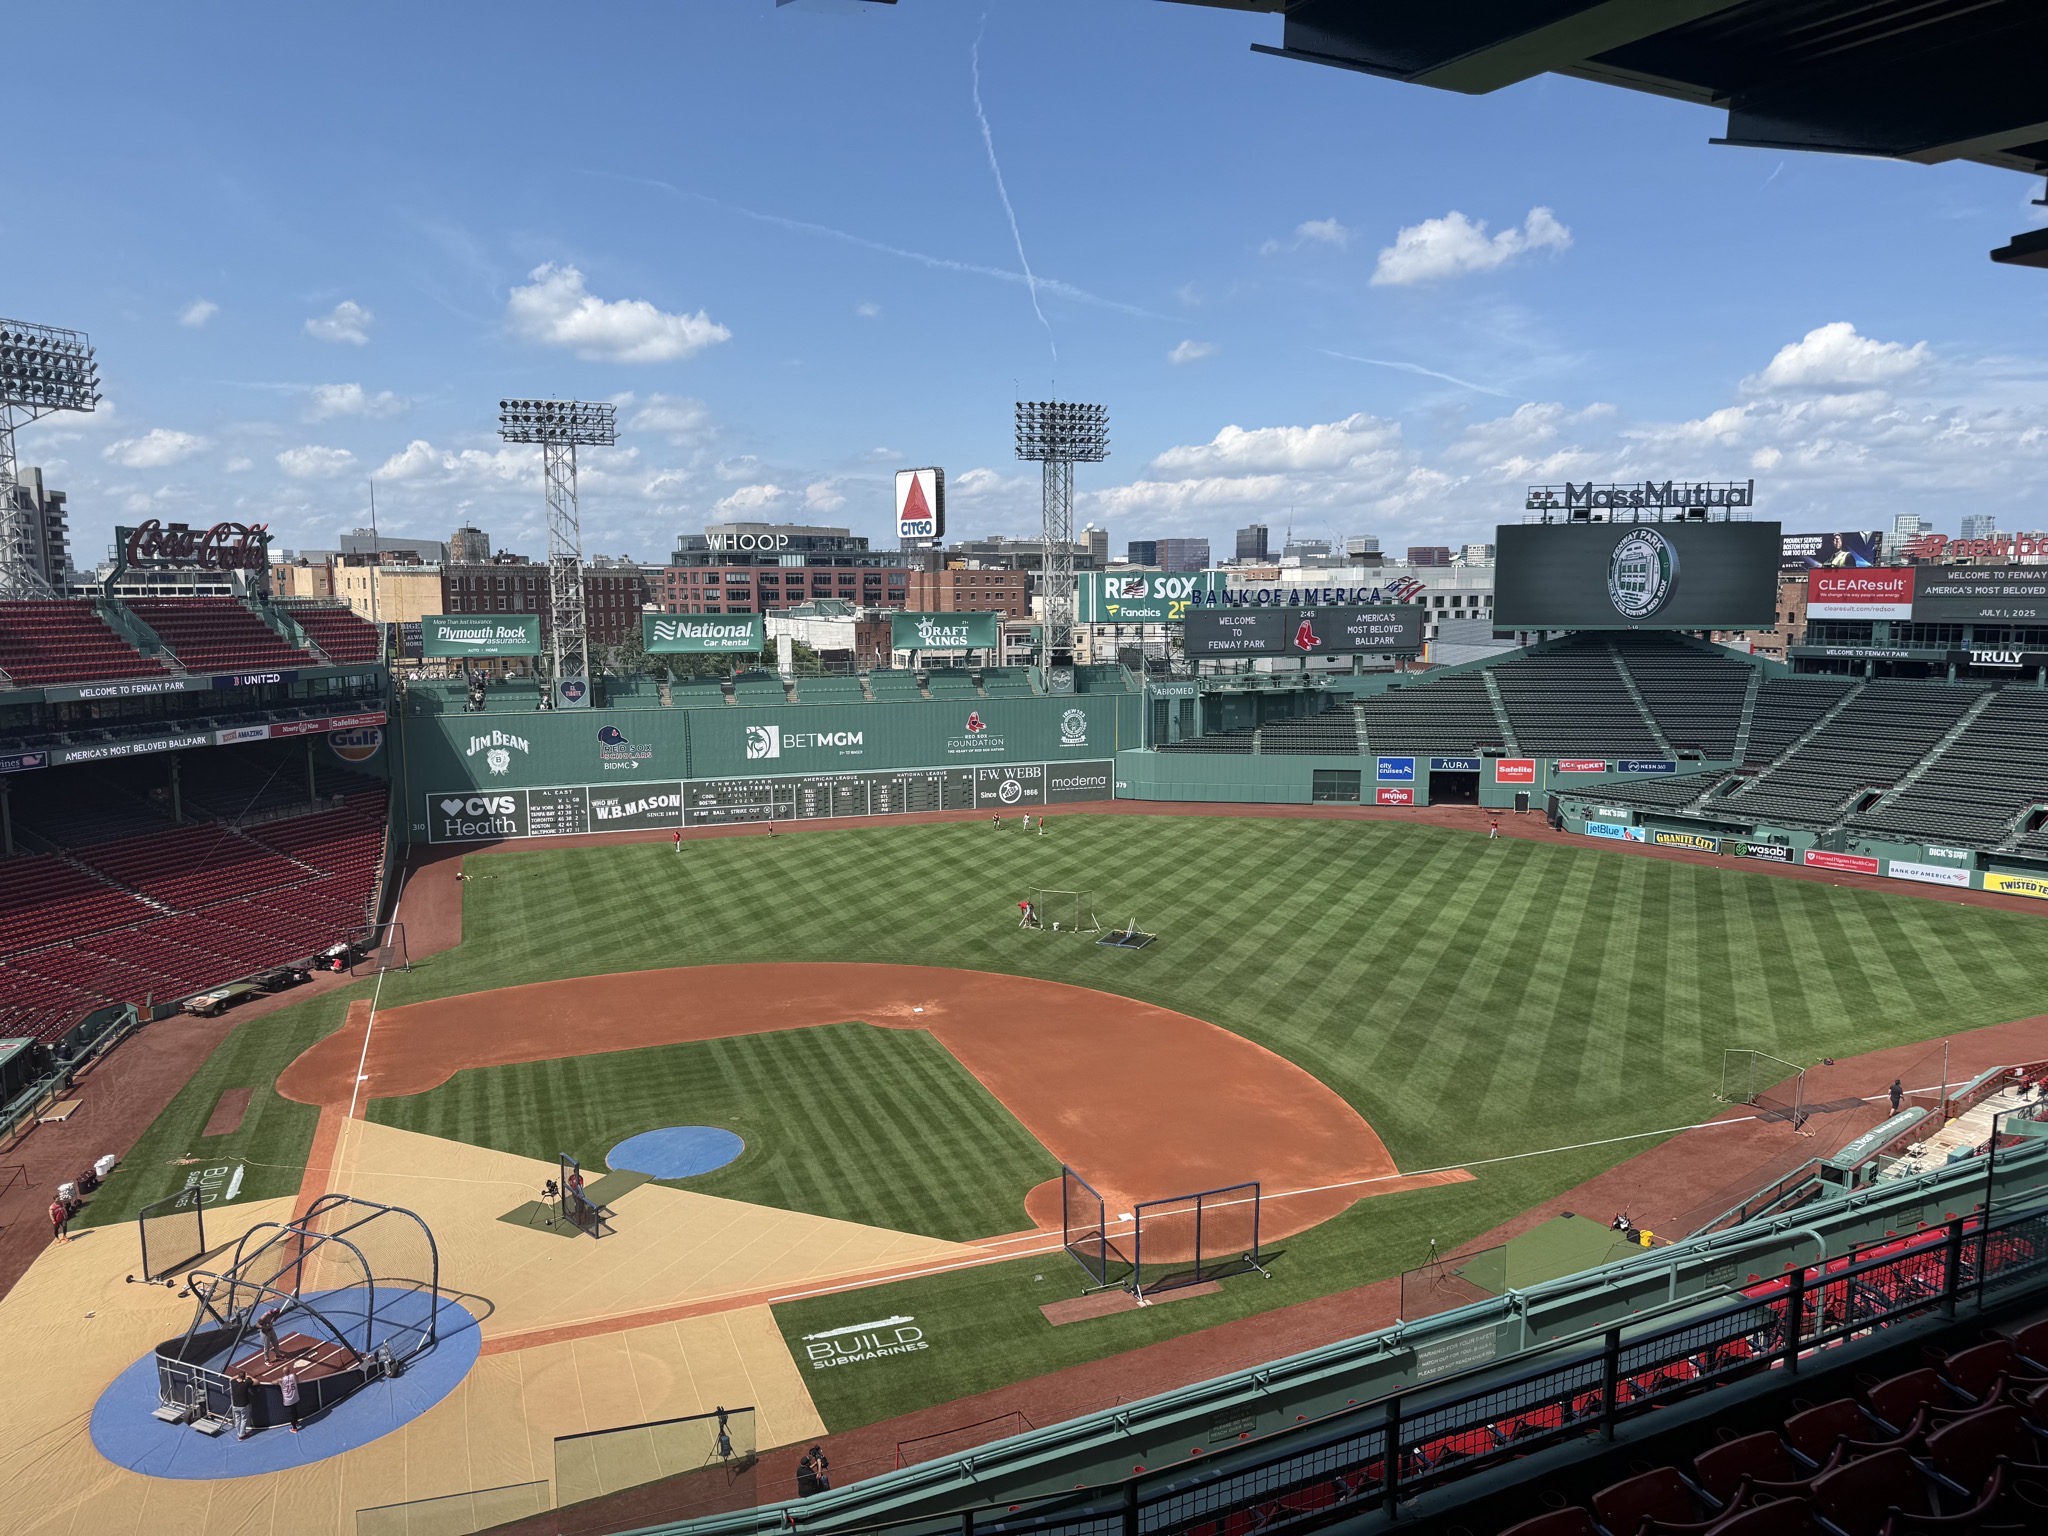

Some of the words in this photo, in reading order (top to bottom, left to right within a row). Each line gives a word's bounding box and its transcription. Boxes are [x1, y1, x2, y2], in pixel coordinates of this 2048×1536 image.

[1565, 479, 1754, 508] MassMutual
[901, 520, 932, 536] CITGO
[127, 518, 268, 570] Coca-Cola
[705, 534, 788, 550] WHOOP
[1612, 530, 1639, 559] FENWAY
[1640, 530, 1664, 553] PARK
[1953, 539, 2012, 557] new
[1948, 571, 1990, 580] WELCOME
[1993, 571, 2005, 579] TO
[2008, 571, 2048, 579] FENWAY
[1105, 578, 1150, 599] RED
[1153, 577, 1198, 599] SOX
[1818, 579, 1904, 591] CLEAResult
[1925, 585, 1972, 595] AMERICA'S
[1975, 586, 2000, 594] MOST
[2003, 586, 2046, 595] BELOVED
[1191, 589, 1248, 605] BANK
[1257, 589, 1282, 604] OF
[1288, 587, 1381, 603] AMERICA
[1121, 607, 1161, 617] Fanatics
[1300, 610, 1315, 618] 2:45
[1979, 609, 2001, 617] JULY
[2012, 609, 2036, 617] 2025
[1219, 617, 1256, 626] WELCOME
[1356, 614, 1396, 623] AMERICA'S
[437, 626, 493, 640] Plymouth
[496, 626, 526, 638] Rock
[918, 624, 969, 639] DRAFT
[1232, 629, 1242, 637] TO
[1347, 625, 1371, 634] MOST
[1372, 625, 1404, 633] BELOVED
[703, 639, 719, 647] Car
[721, 638, 749, 646] Rental
[925, 636, 968, 646] KINGS
[1208, 641, 1242, 649] FENWAY
[1243, 640, 1265, 648] PARK
[1355, 636, 1395, 645] BALLPARK
[1826, 649, 1854, 657] WELCOME
[1970, 651, 2023, 663] TRULY
[244, 673, 280, 686] UNITED
[79, 687, 118, 698] WELCOME
[120, 686, 130, 694] TO
[131, 683, 163, 693] FENWAY
[165, 682, 185, 690] PARK
[1156, 687, 1194, 696] ABIOMED
[332, 717, 359, 728] Safelite
[329, 729, 379, 747] Gulf
[466, 734, 491, 757] JIM
[493, 730, 531, 754] BEAM
[783, 731, 863, 749] BETMGM
[947, 738, 1005, 747] FOUNDATION
[65, 747, 108, 761] AMERICA'S
[110, 745, 131, 756] MOST
[133, 740, 167, 752] BELOVED
[169, 736, 207, 747] BALLPARK
[604, 744, 626, 753] RED
[629, 743, 652, 752] SOX
[604, 762, 630, 770] BIDMC
[1576, 761, 1604, 771] TICKET
[1004, 767, 1041, 778] WEBB
[1051, 776, 1107, 788] moderna
[1116, 781, 1127, 789] 379
[980, 790, 997, 799] Since
[1023, 788, 1038, 796] 1866
[465, 796, 516, 814] CVS
[1599, 808, 1617, 817] DICK'S
[412, 823, 426, 831] 310
[444, 816, 518, 837] Health
[1588, 822, 1620, 836] jetBlue
[1656, 833, 1694, 844] GRANITE
[1695, 836, 1715, 850] CITY
[1747, 844, 1786, 857] wasabi
[1929, 847, 1953, 858] DICK'S
[1920, 871, 1951, 880] AMERICA
[1999, 881, 2037, 891] TWISTED
[806, 1326, 923, 1361] BUILD
[813, 1341, 929, 1370] SUBMARINES
[1417, 1368, 1436, 1377] PLEASE
[1455, 1357, 1472, 1366] REACH
[1472, 1353, 1485, 1361] OVER
